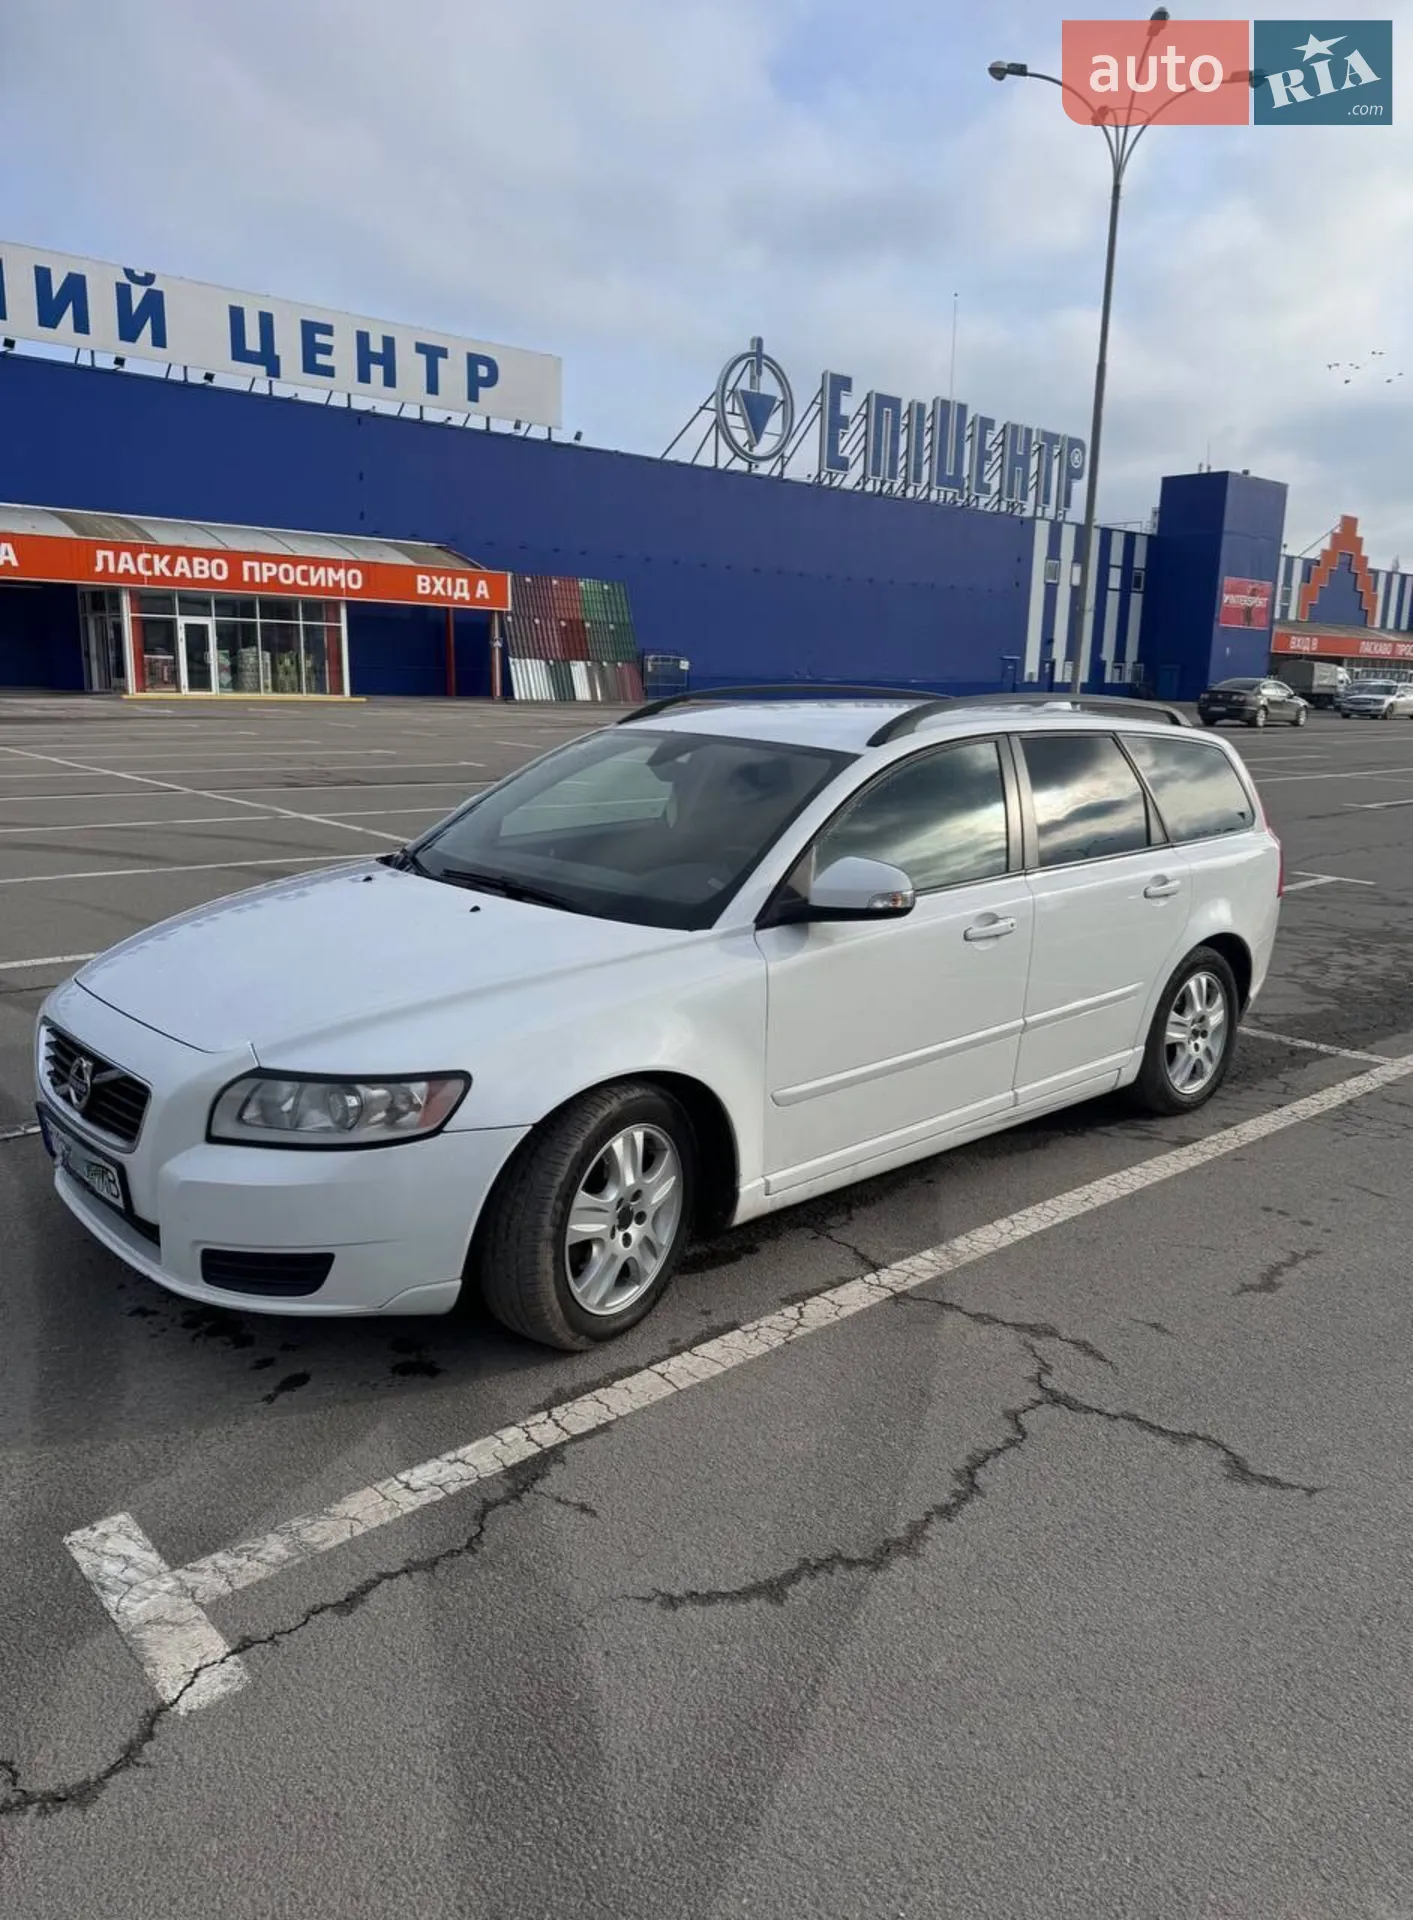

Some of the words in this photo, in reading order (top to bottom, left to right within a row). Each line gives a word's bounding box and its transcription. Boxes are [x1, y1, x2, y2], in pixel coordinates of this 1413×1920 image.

[0, 257, 168, 349] ИЙ
[228, 304, 500, 403] ЦЕНТР
[819, 369, 1087, 511] ЕПІЦЕНТР
[94, 549, 229, 581] ЛАСКАВО
[242, 560, 363, 589] ПРОСИМО
[416, 574, 471, 601] ВХІД
[475, 579, 490, 599] А
